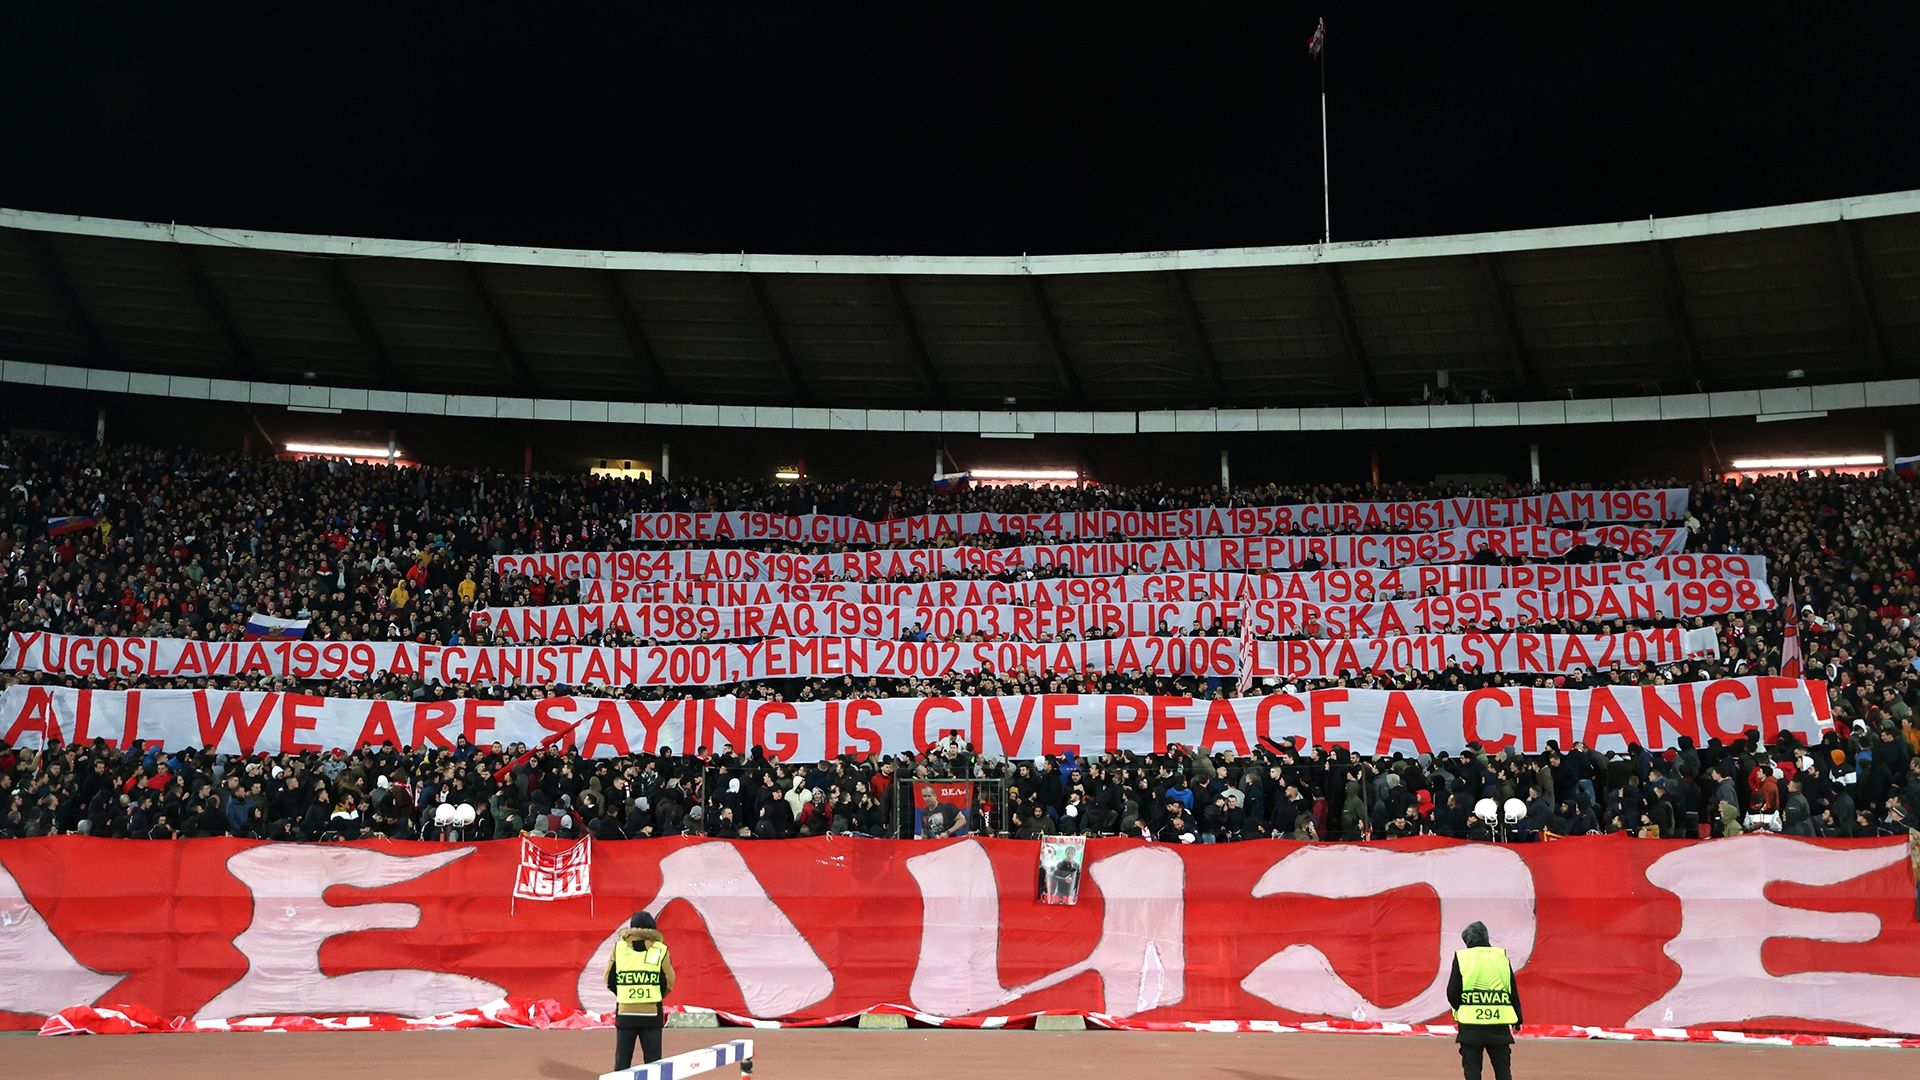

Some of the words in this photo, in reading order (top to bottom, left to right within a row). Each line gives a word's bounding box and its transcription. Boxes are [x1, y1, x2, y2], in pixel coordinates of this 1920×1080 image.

[634, 511, 735, 540] KOREA
[741, 511, 810, 542] 1950,
[812, 512, 997, 544] GUATEMALA
[997, 513, 1070, 540] 1954,
[1074, 507, 1224, 537] INDONESIA
[1302, 503, 1380, 530] CUBA
[1385, 500, 1454, 530] 1961,
[1452, 492, 1595, 527] VIETNAM
[1600, 491, 1677, 521] 1961,
[497, 551, 599, 583] CONGO
[605, 551, 681, 581] 1964,
[685, 550, 760, 580] LAOS
[843, 549, 943, 583] BRASIL
[1036, 541, 1205, 576] DOMINICAN
[1220, 536, 1377, 570] REPUBLIC
[1382, 530, 1468, 567] 1965,
[470, 604, 633, 643] PANAMA
[636, 604, 731, 640] 1989,
[734, 602, 819, 636] IRAQ
[915, 603, 1009, 641] 2003,
[1013, 602, 1180, 641] REPUBLIC
[1255, 598, 1406, 640] SRPSKA
[1413, 590, 1515, 632] 1995,
[1516, 584, 1655, 626] SUDAN
[1664, 577, 1775, 618] 1998,
[587, 580, 778, 607] ARGENTINA
[861, 579, 1055, 608] NICARAGUA
[1142, 572, 1308, 603] GRENADA
[12, 631, 272, 678] YUGOSLAVIA
[274, 641, 376, 680] 1999
[389, 643, 638, 687] AFGANISTAN
[646, 644, 739, 684] 2001,
[737, 636, 868, 676] YEMEN
[971, 638, 1142, 677] SOMALIA
[1251, 637, 1363, 678] LIBYA
[1461, 633, 1594, 673] SYRIA
[3, 687, 165, 752] ALL
[192, 689, 324, 757] WE
[355, 699, 505, 752] ARE
[535, 695, 799, 762] SAYING
[825, 700, 883, 763] IS
[912, 694, 1081, 763] GIVE
[1105, 689, 1349, 756] PEACE
[1375, 691, 1435, 755] A
[1462, 676, 1836, 754] CHANCE!
[616, 972, 660, 983] STEWAR
[628, 988, 651, 999] 291
[1461, 992, 1512, 1004] STEWAR
[1475, 1008, 1501, 1020] 294
